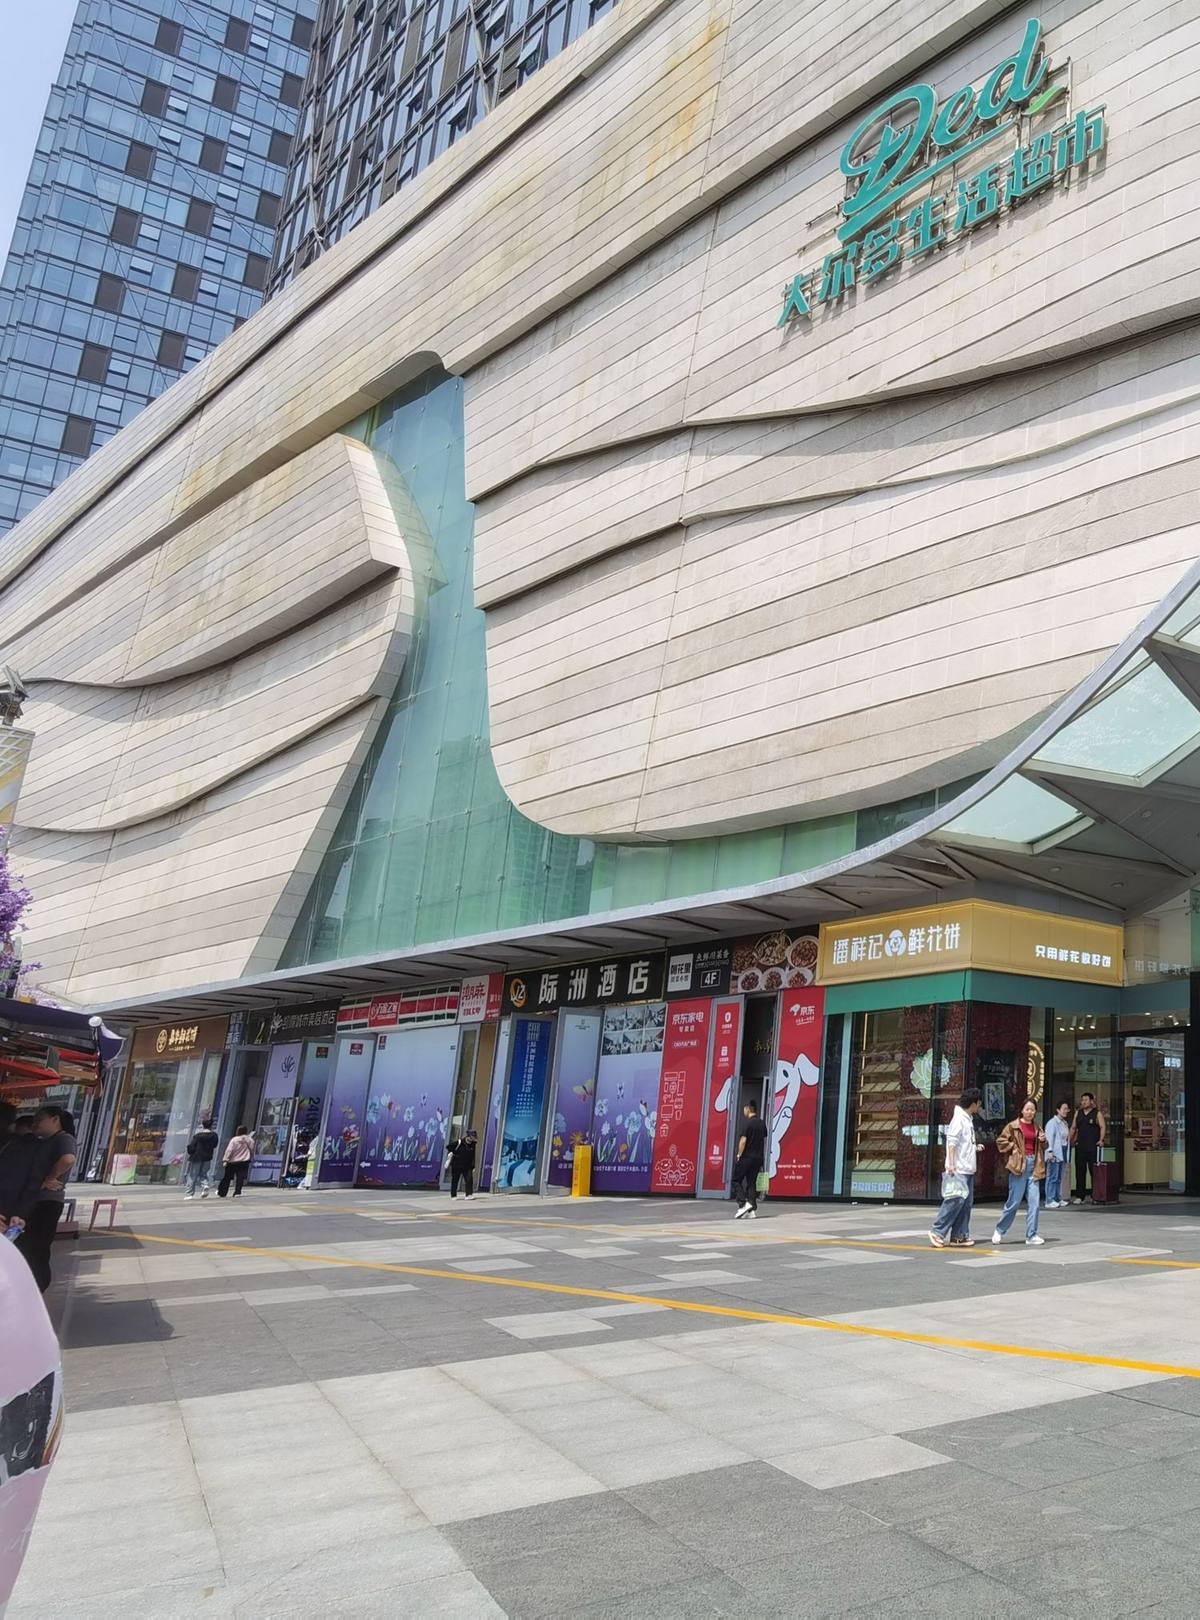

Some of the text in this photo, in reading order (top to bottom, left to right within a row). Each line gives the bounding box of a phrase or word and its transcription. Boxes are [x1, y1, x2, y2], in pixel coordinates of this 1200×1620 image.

[833, 923, 960, 965] 潘祥记 鲜花饼
[538, 960, 650, 1005] 际洲酒店
[704, 972, 717, 985] 4F
[672, 1011, 704, 1025] 京东家电
